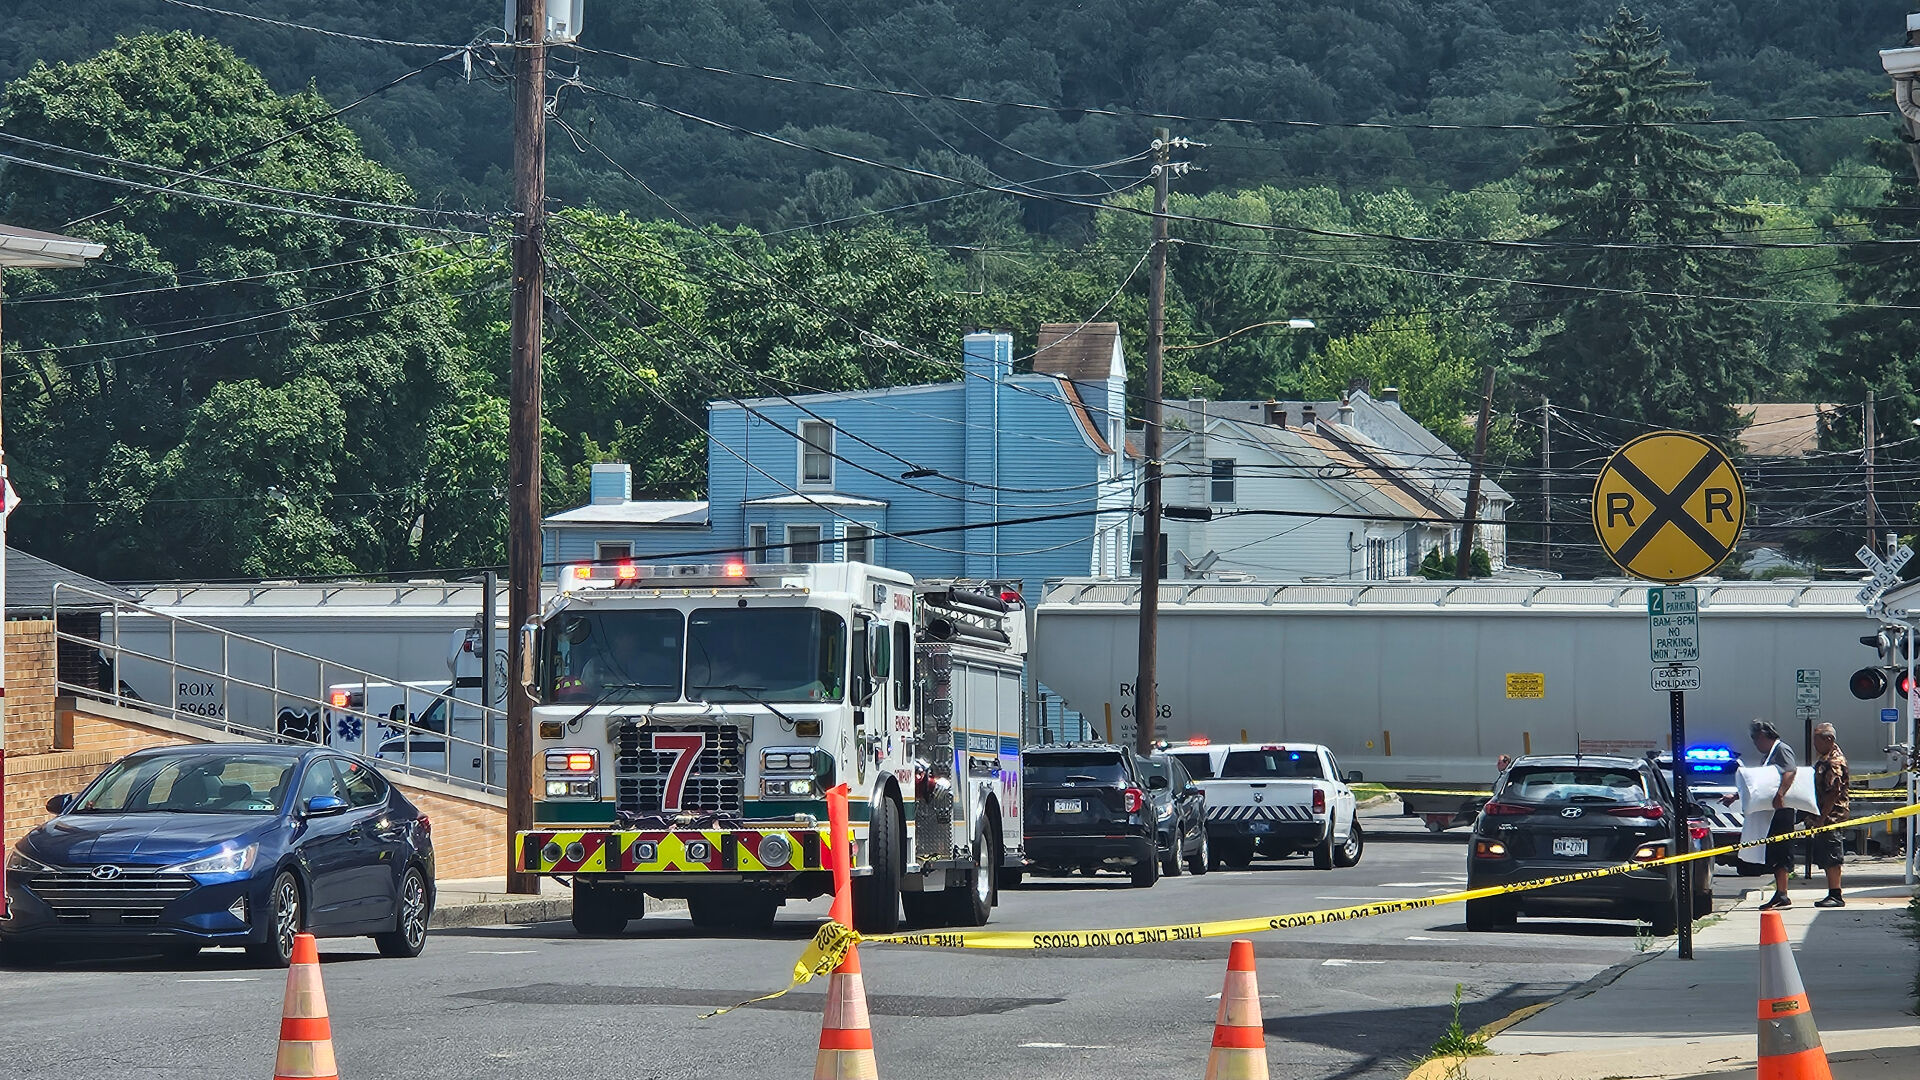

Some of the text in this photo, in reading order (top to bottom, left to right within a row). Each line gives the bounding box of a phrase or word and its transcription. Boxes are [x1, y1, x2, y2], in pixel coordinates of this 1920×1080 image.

[1606, 488, 1734, 528] R R
[1858, 549, 1878, 572] RAIL
[1861, 550, 1909, 600] CROSSING
[1652, 592, 1661, 611] 2
[1672, 591, 1686, 600] HR
[1666, 602, 1695, 612] PARKING
[1653, 616, 1695, 627] 8AM-8PM
[1668, 627, 1680, 637] NO
[1657, 638, 1693, 648] PARKING
[1659, 669, 1692, 678] EXCEPT
[179, 683, 215, 697] ROIX
[1654, 680, 1697, 689] HOLIDAYS
[652, 732, 706, 813] 7
[1033, 926, 1202, 949] FIRE LINE DO NOT CROSS
